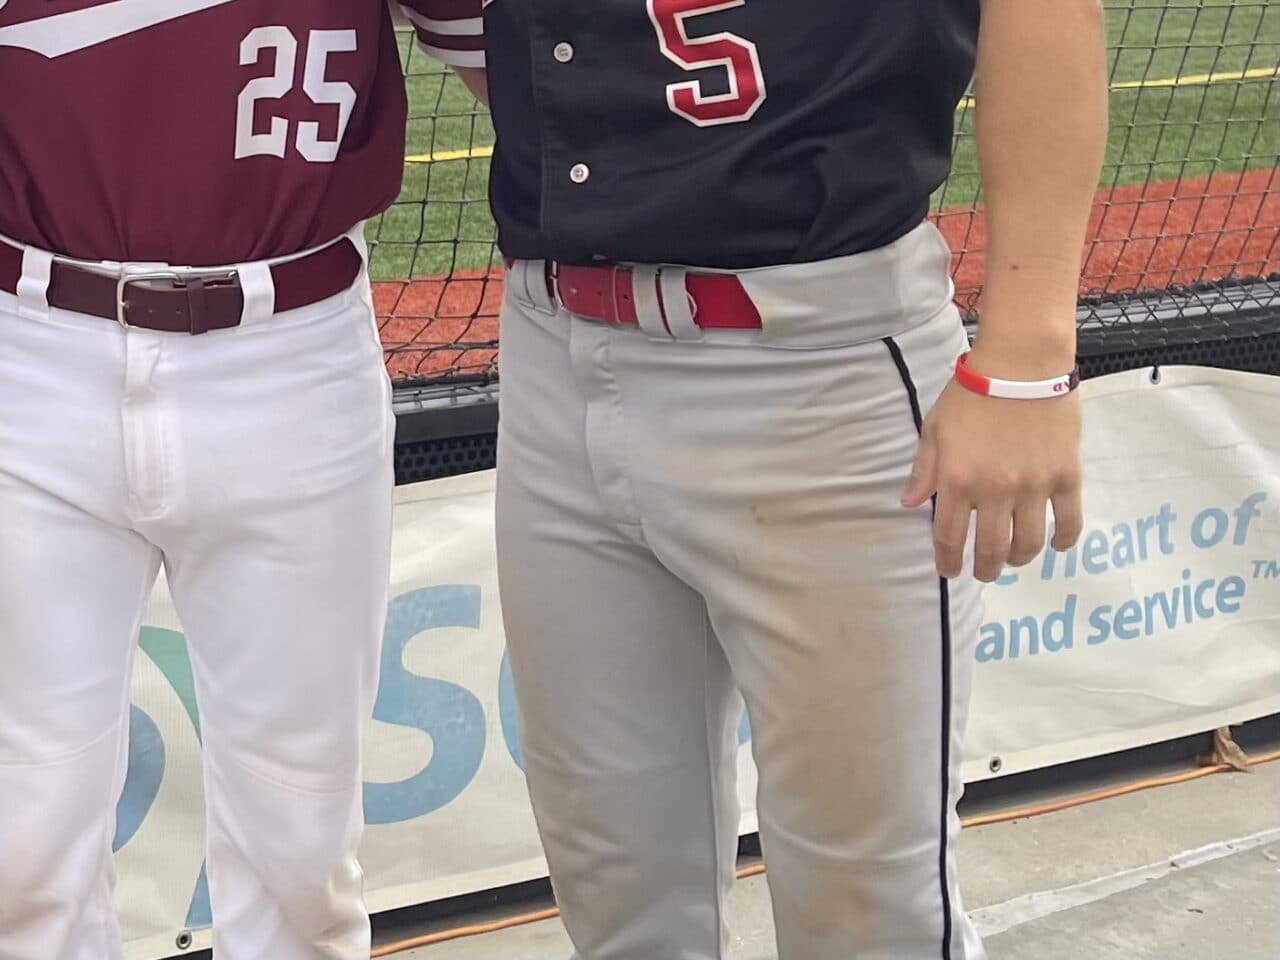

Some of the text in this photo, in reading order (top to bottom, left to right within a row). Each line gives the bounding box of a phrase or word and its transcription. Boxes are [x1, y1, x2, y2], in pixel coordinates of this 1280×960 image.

[234, 25, 357, 163] 25
[1190, 491, 1268, 550] of
[974, 593, 1078, 664] and
[1086, 567, 1247, 646] service
